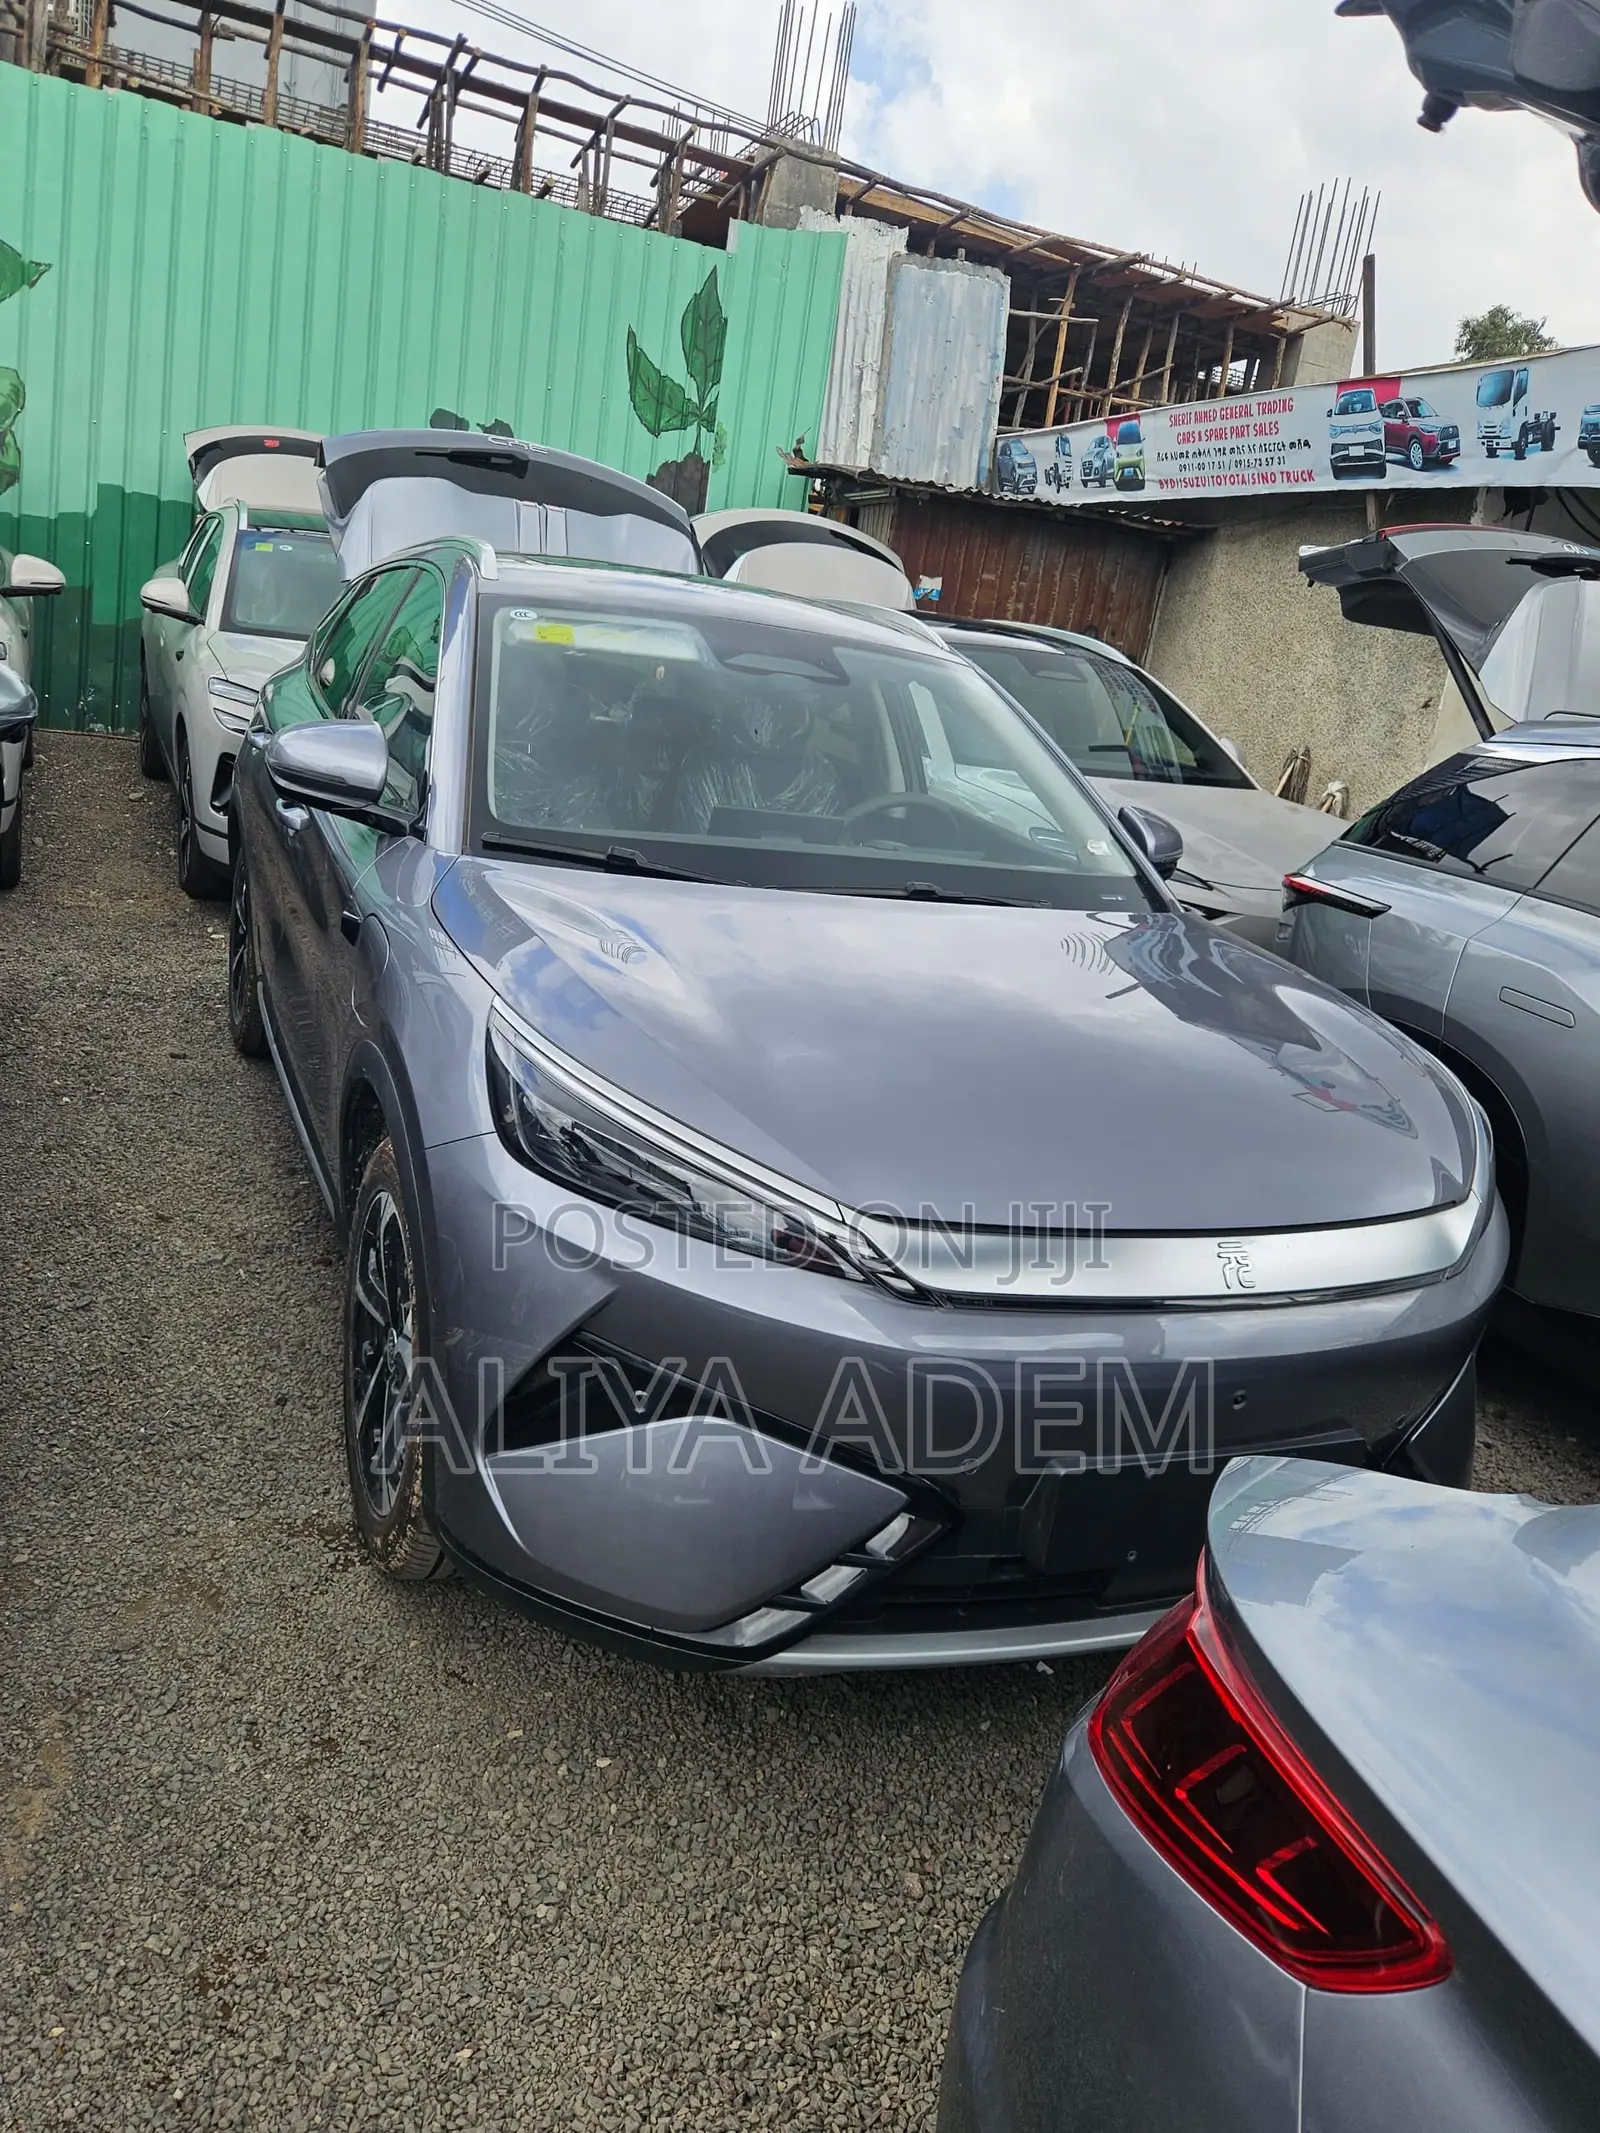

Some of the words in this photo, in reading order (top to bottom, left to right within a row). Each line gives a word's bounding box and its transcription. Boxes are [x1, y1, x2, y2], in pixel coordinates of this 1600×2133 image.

[1169, 411, 1192, 427] SHERIF
[1194, 408, 1217, 424] AHMED
[1220, 403, 1253, 420] GENERAL
[1256, 397, 1294, 415] TRADING
[1177, 430, 1195, 445] CARS
[1204, 427, 1228, 442] SPARE
[1230, 424, 1250, 440] PART
[1253, 420, 1279, 437] SALES
[1208, 461, 1215, 470] 17
[1234, 457, 1262, 469] 0915-73
[1265, 456, 1274, 467] 57
[1277, 455, 1286, 465] 31
[1280, 468, 1316, 484] TRUCK
[1217, 1241, 1257, 1289] 元
